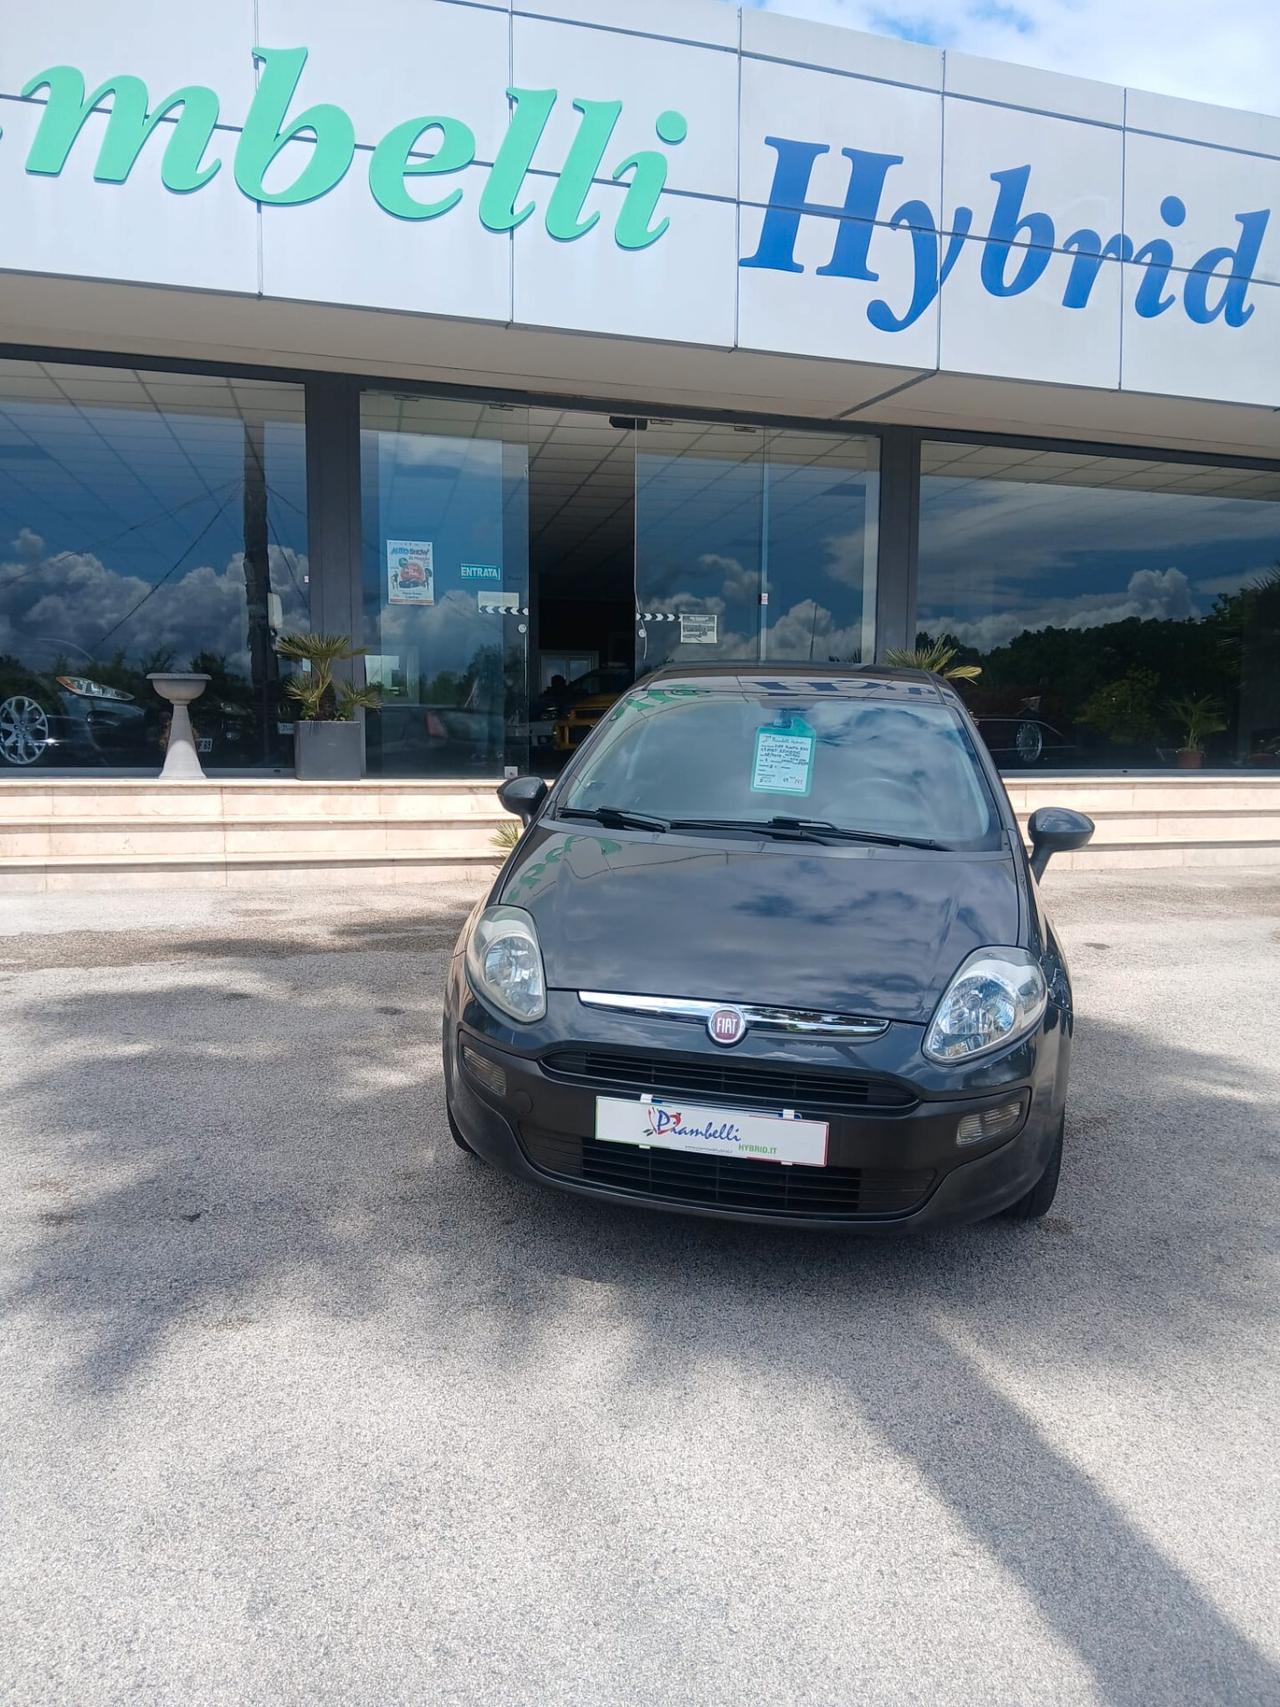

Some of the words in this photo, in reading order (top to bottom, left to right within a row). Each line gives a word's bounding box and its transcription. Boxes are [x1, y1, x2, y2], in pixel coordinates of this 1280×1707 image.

[0, 46, 688, 250] mbelli
[738, 135, 1271, 333] Hybrid
[461, 566, 498, 578] ENTRATA
[716, 1017, 737, 1034] FIAT
[738, 1143, 777, 1155] HYBRID.IT
